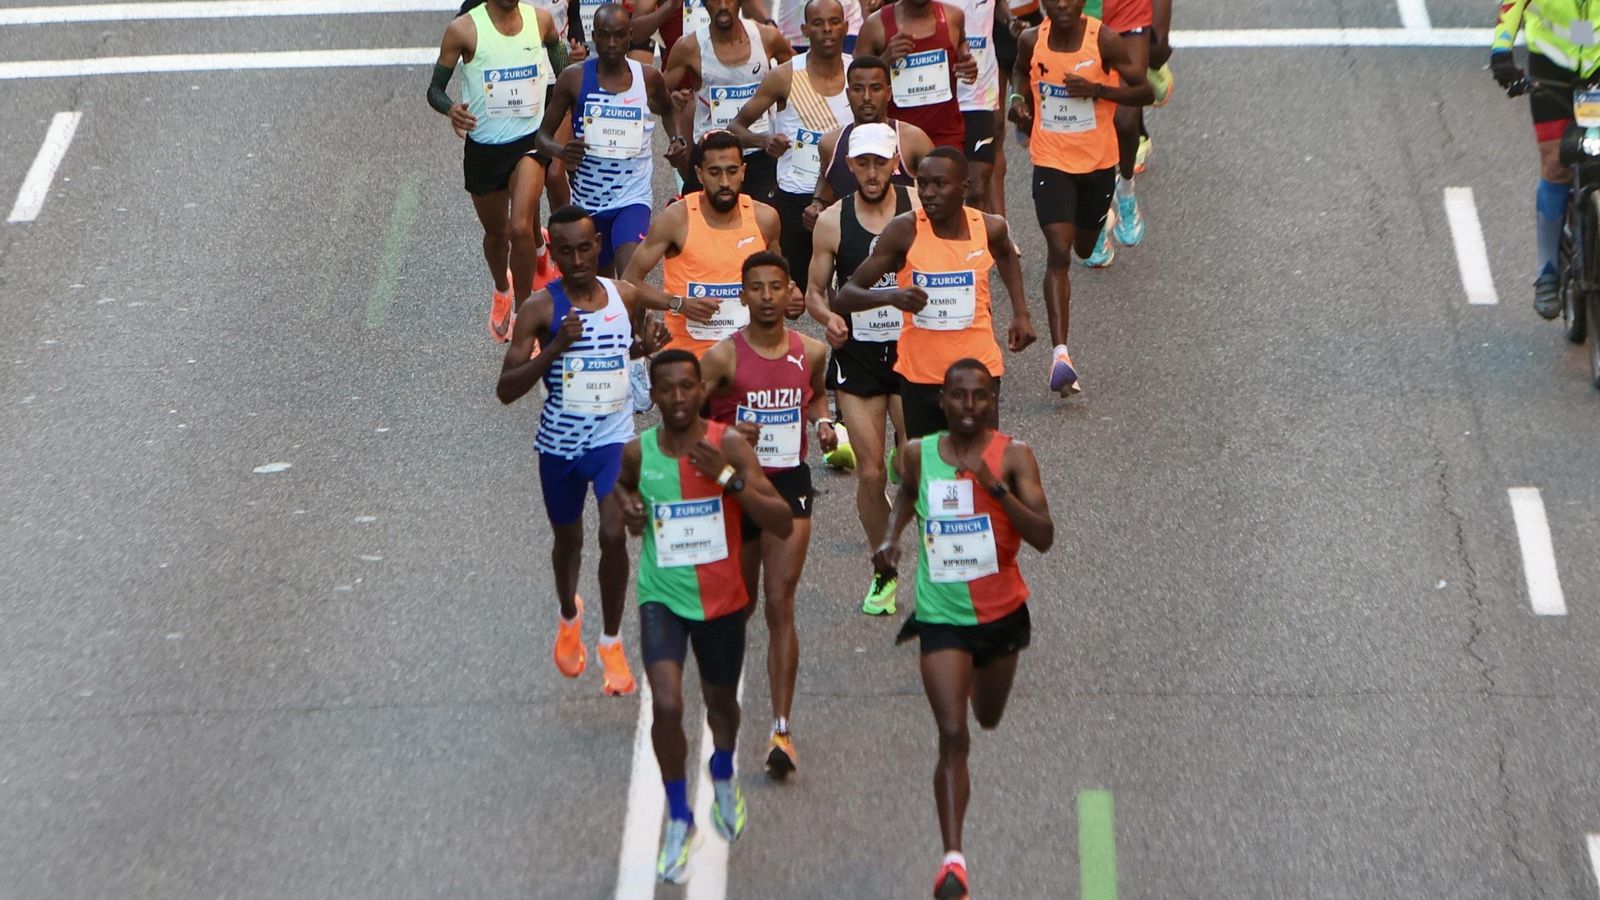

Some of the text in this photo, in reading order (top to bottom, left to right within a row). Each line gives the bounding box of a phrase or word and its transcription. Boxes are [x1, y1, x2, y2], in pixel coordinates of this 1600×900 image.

[910, 54, 940, 66] ZURICH
[503, 69, 533, 79] ZURICH
[510, 88, 518, 96] 11
[908, 84, 936, 94] BERHANE
[605, 108, 636, 118] ZURICH
[1059, 104, 1067, 112] 21
[603, 128, 626, 136] ROTICH
[931, 276, 966, 286] ZURICH
[878, 310, 888, 318] 64
[588, 360, 619, 369] ZURICH
[586, 382, 611, 390] GELETA
[747, 388, 802, 409] POLIZIA
[760, 413, 794, 423] ZURICH
[763, 433, 774, 441] 43
[946, 485, 958, 499] 36
[675, 503, 713, 517] ZURICH
[945, 521, 981, 533] ZURICH
[683, 528, 694, 537] 37
[953, 545, 964, 554] 36
